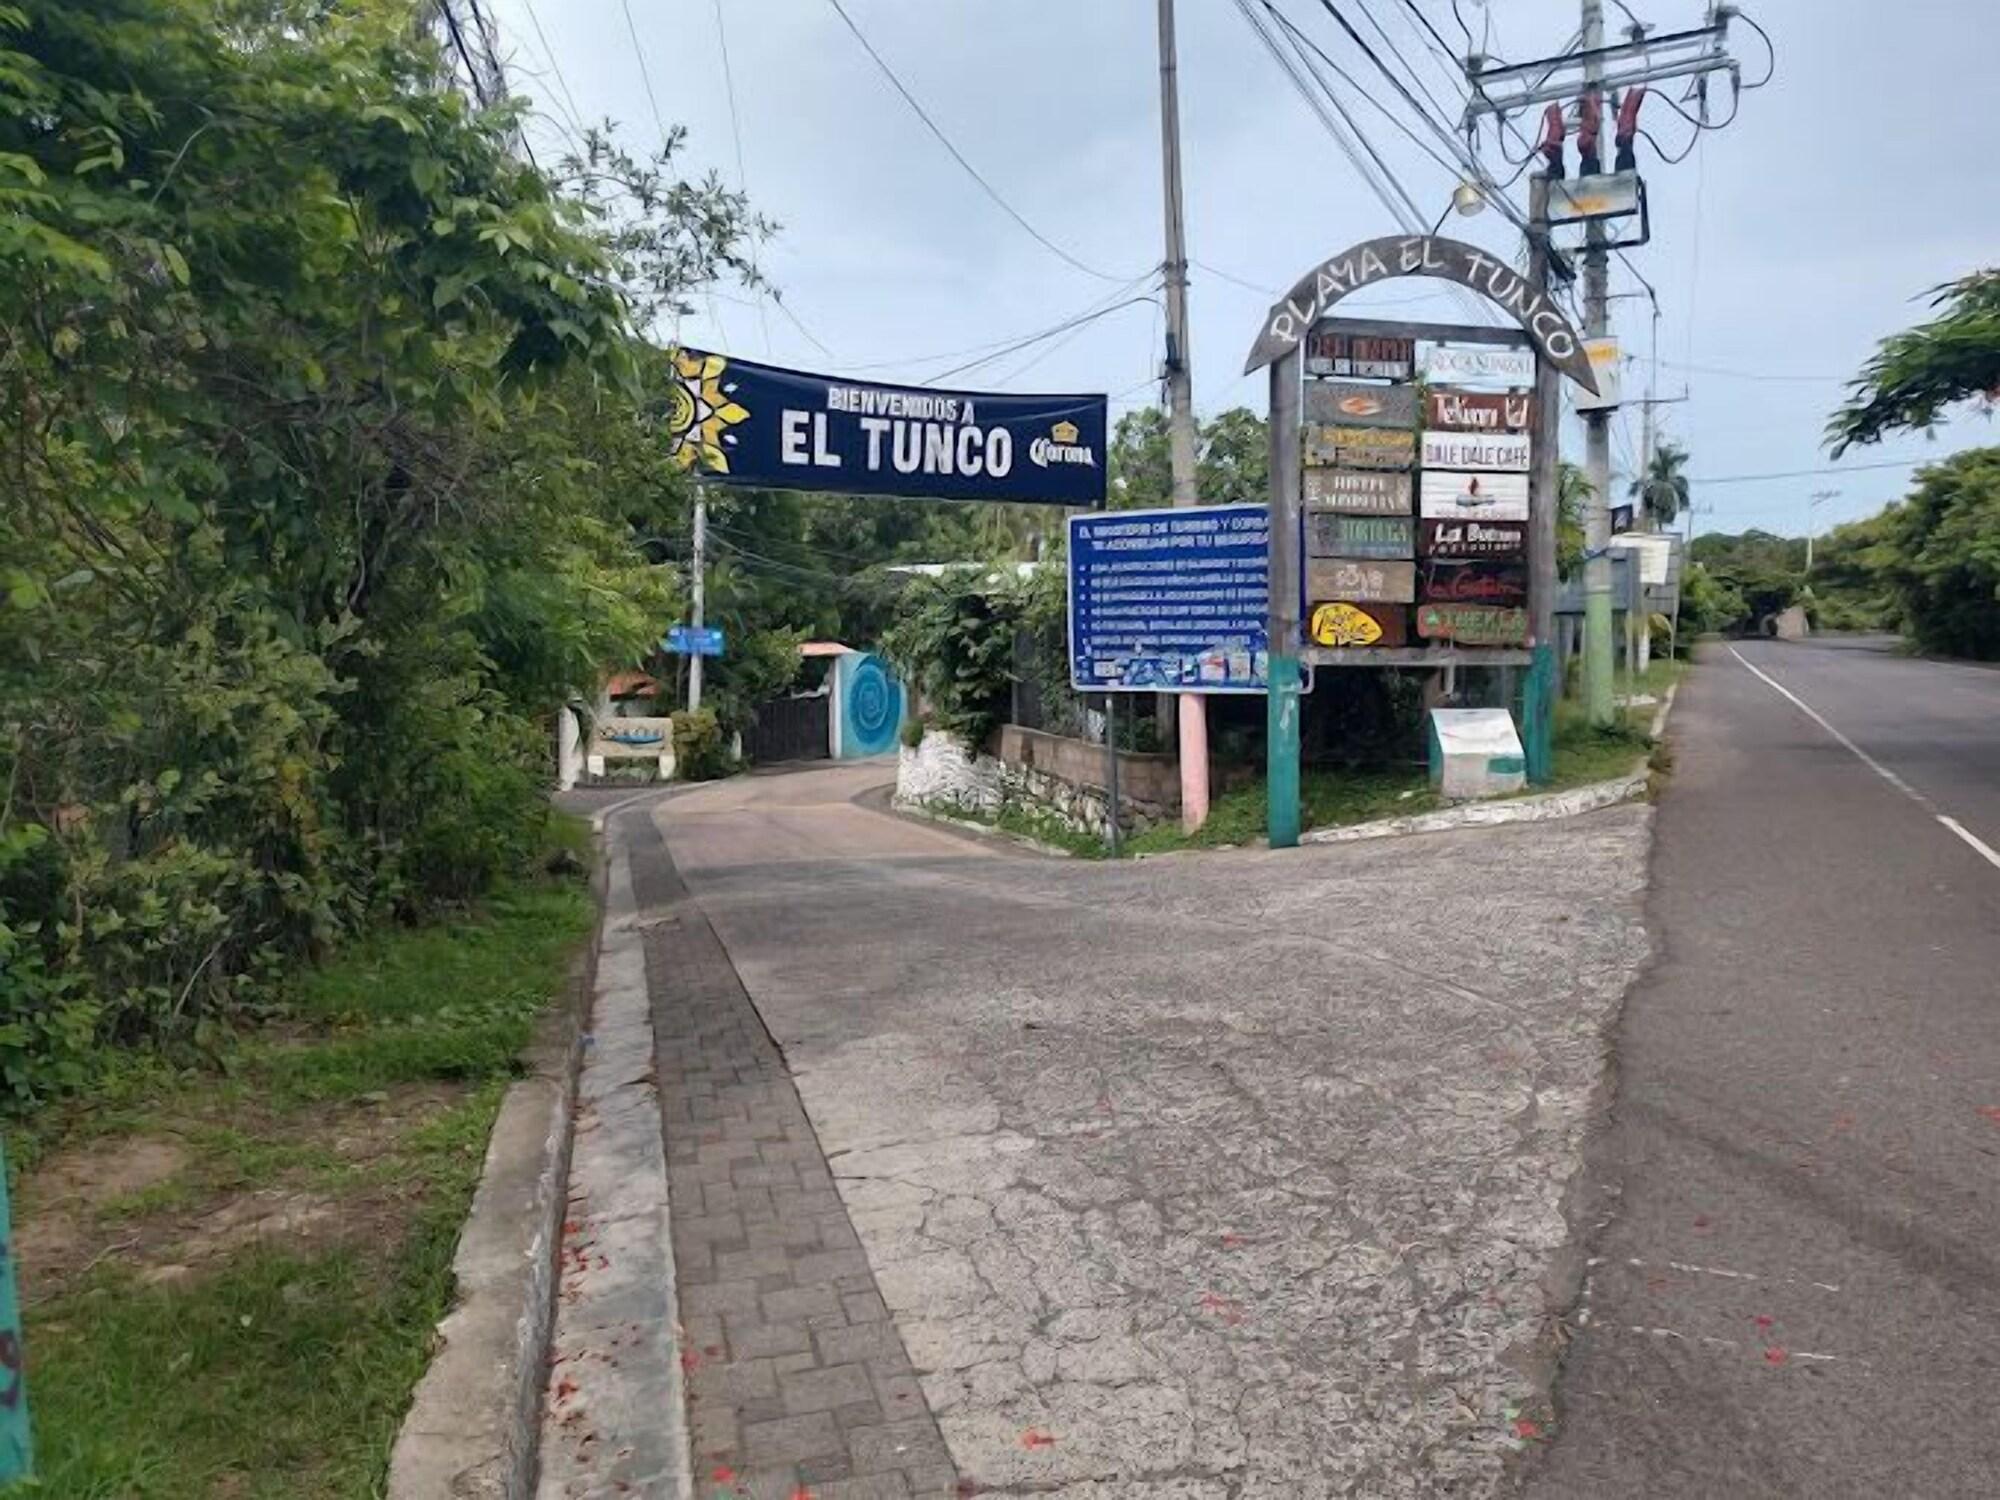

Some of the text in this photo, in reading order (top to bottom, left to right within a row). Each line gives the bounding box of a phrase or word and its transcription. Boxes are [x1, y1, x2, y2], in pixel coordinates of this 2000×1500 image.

[1271, 238, 1575, 359] PLAYA EL TUNCO
[827, 386, 975, 425] BIENVENIDOS A
[781, 408, 1013, 478] EL TUNCO
[1029, 436, 1095, 468] Corona
